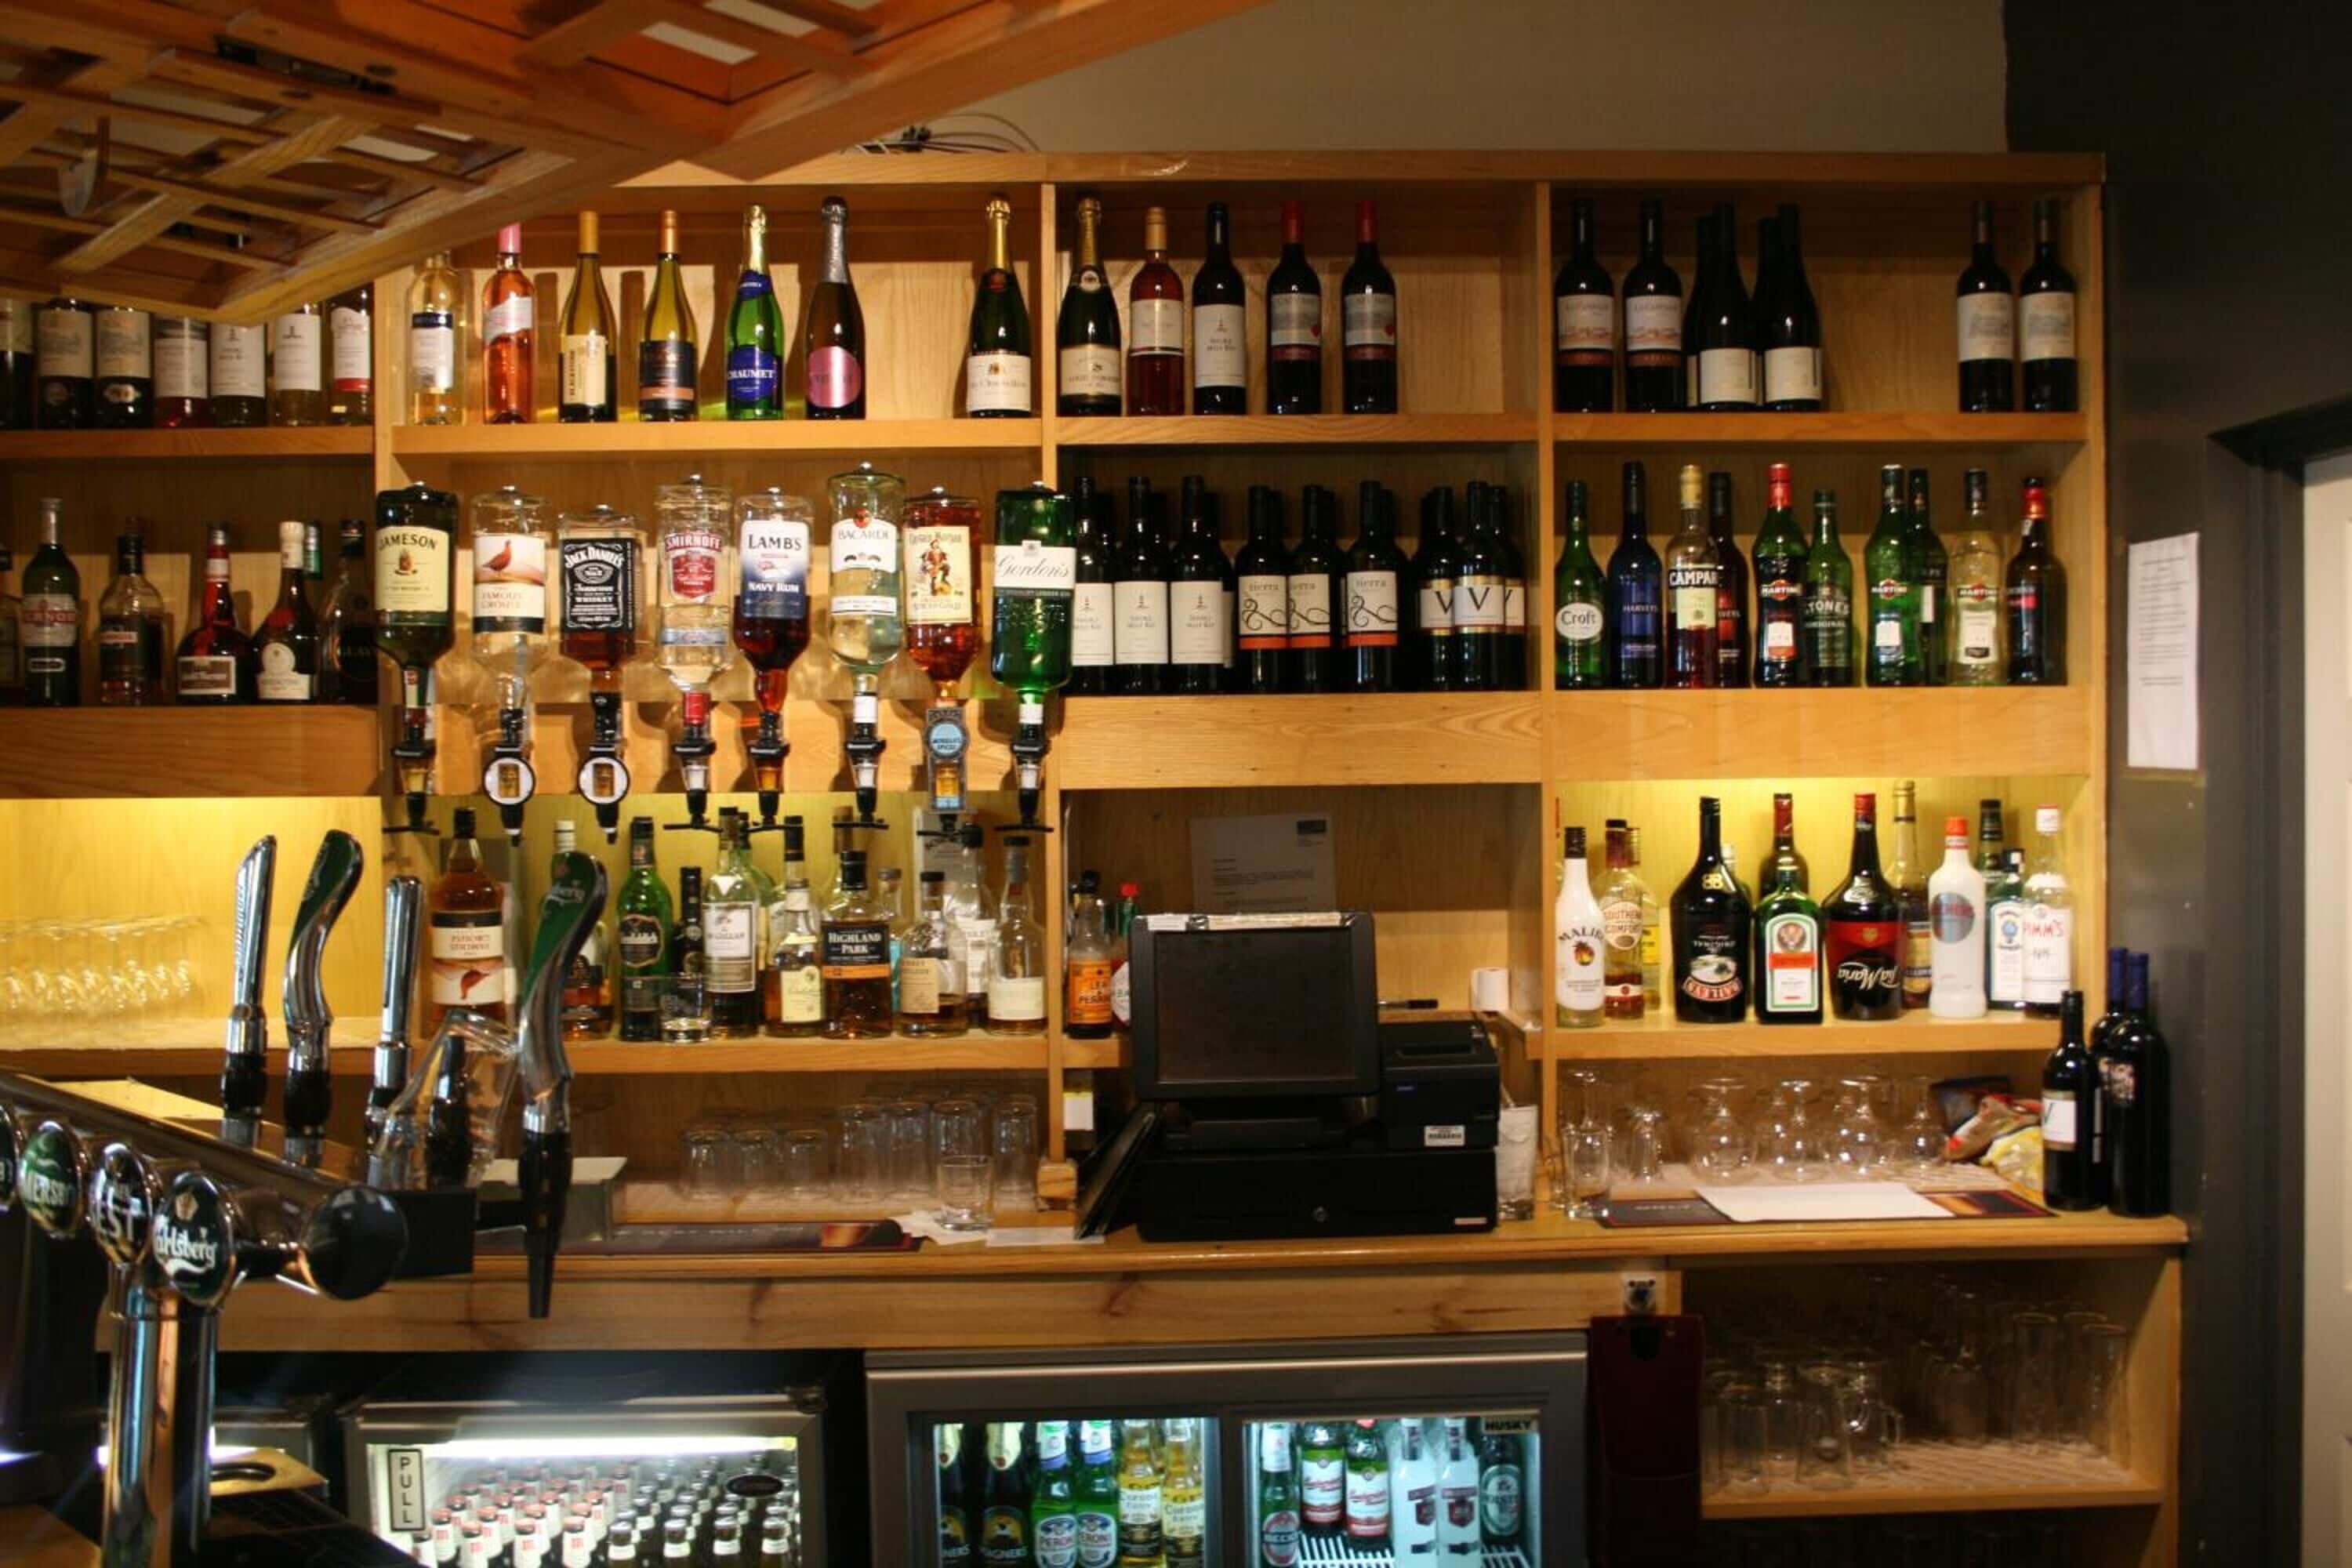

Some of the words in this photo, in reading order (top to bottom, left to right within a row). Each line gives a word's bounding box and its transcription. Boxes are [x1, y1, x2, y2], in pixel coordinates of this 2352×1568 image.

[838, 528, 889, 540] BACARDI
[376, 533, 438, 551] JAMESON
[666, 535, 721, 550] SMIRNOFF
[564, 548, 587, 568] JACK
[998, 554, 1069, 578] Gordon's
[1668, 571, 1719, 586] CAMPAR
[747, 583, 774, 593] NAVY
[775, 583, 800, 593] RUM
[1468, 586, 1491, 611] V
[1560, 610, 1596, 626] Croft
[828, 931, 882, 943] HIGHLAND
[1558, 926, 1605, 942] MALIB
[840, 944, 869, 955] PARK
[1485, 1419, 1532, 1432] HUSKY
[400, 1456, 413, 1524] PULL
